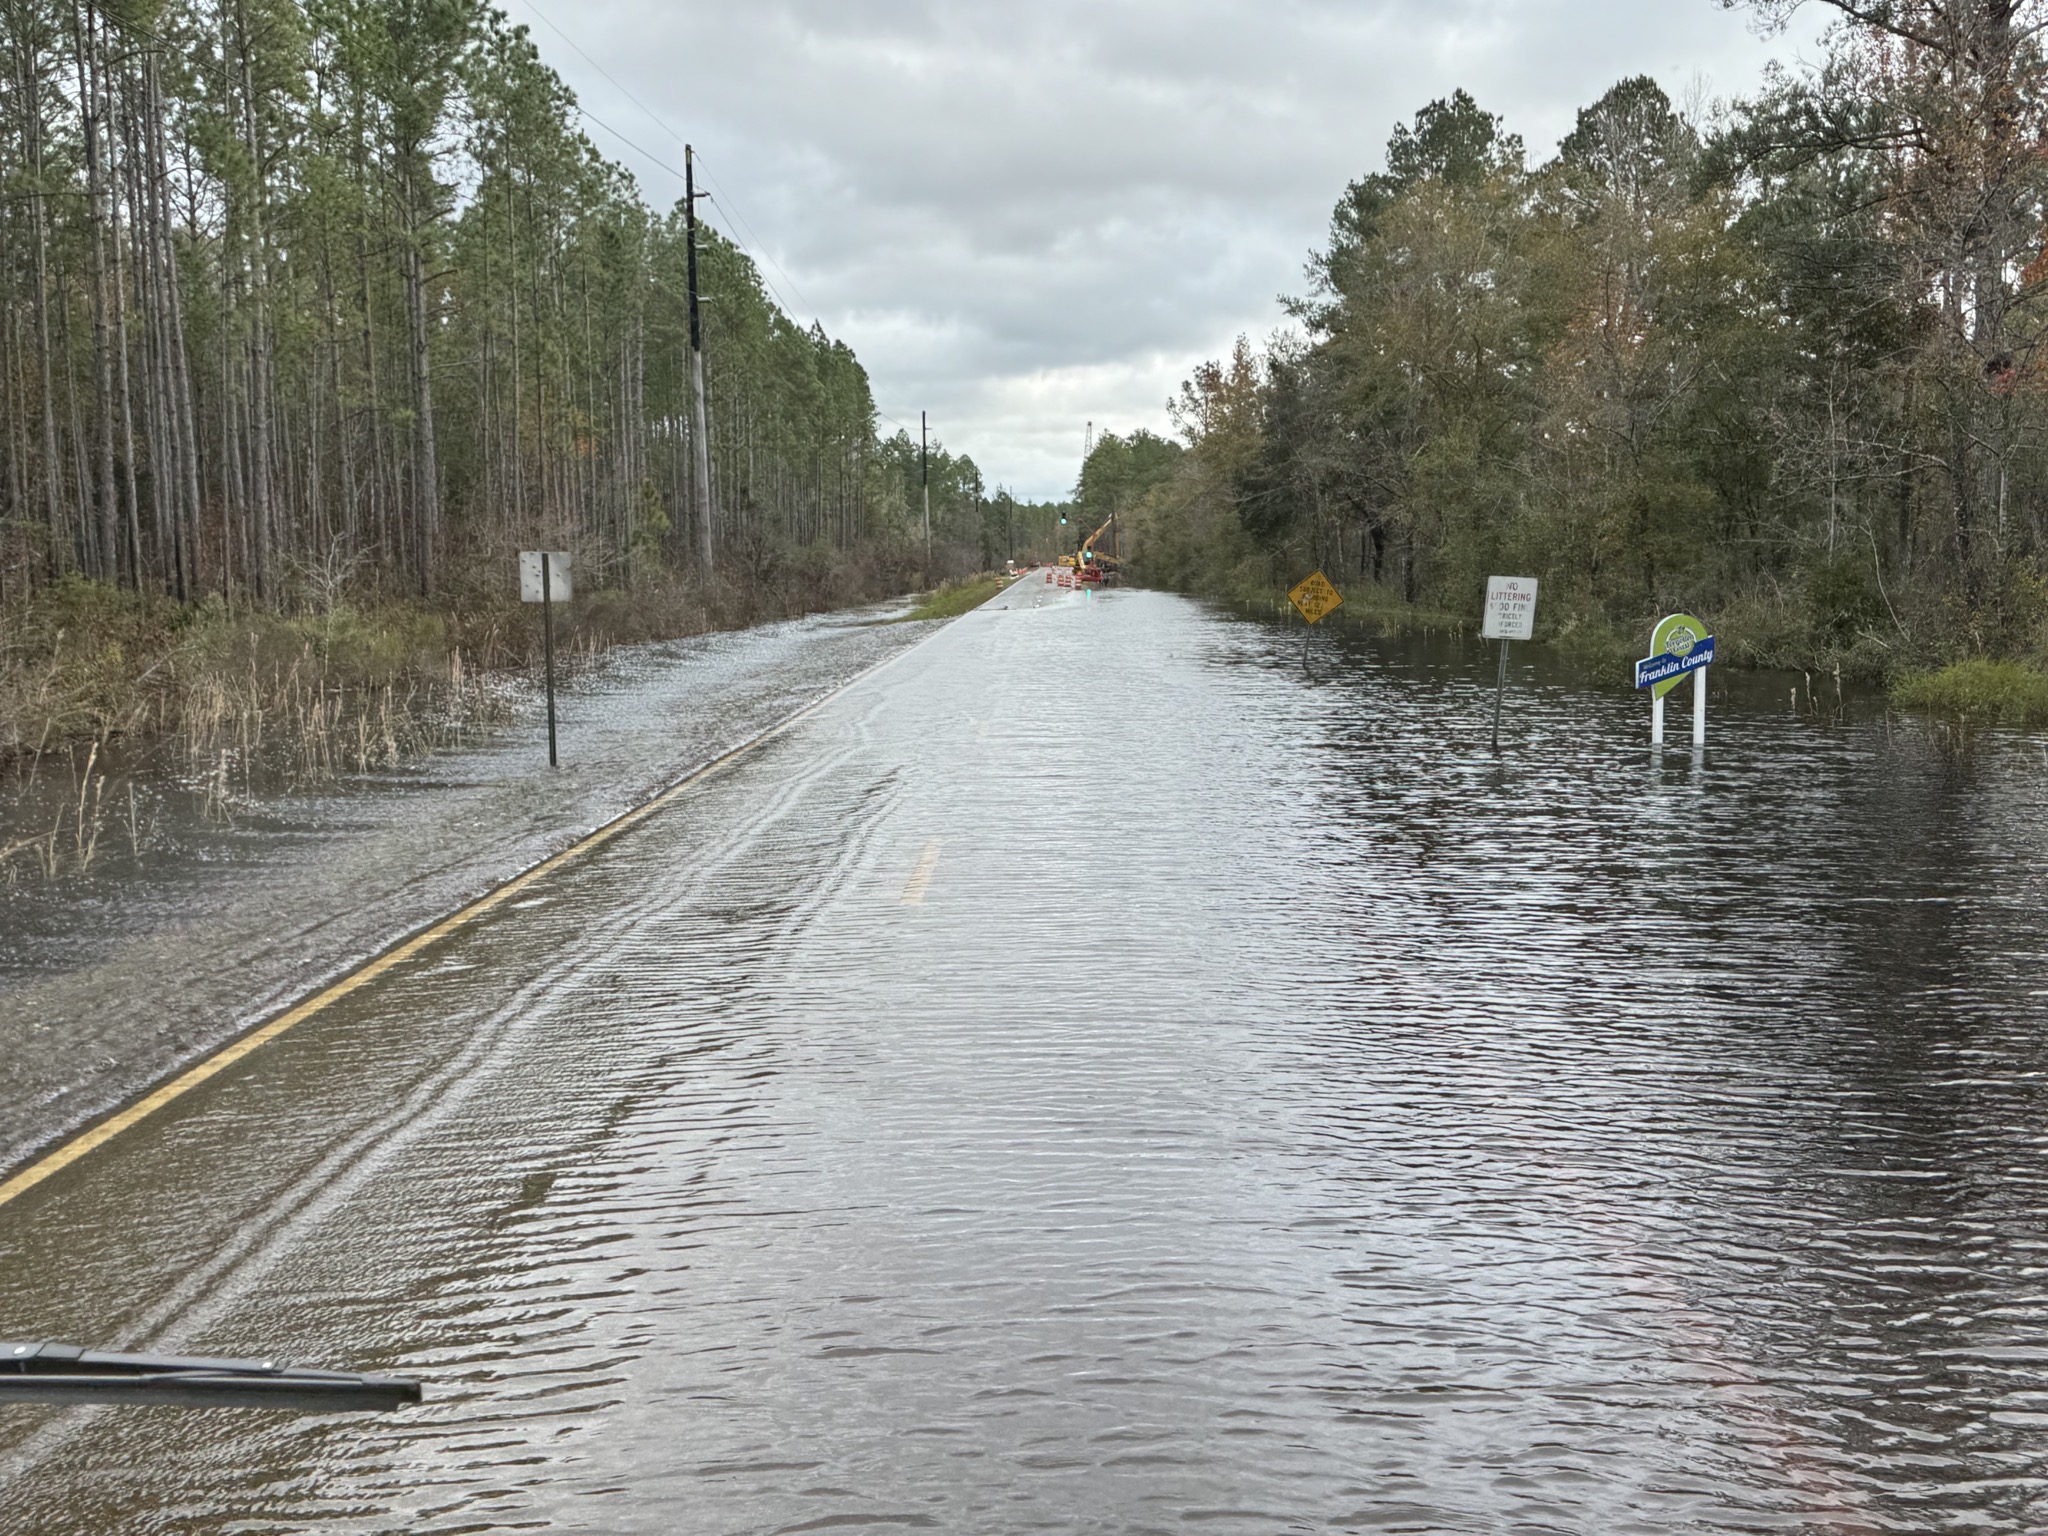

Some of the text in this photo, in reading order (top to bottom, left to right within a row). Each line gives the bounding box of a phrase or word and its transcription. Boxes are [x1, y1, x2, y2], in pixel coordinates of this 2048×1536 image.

[1506, 582, 1518, 590] NO
[1490, 592, 1531, 602] LITTERING
[1513, 603, 1528, 612] FIN
[1639, 650, 1713, 684] Franklin County
